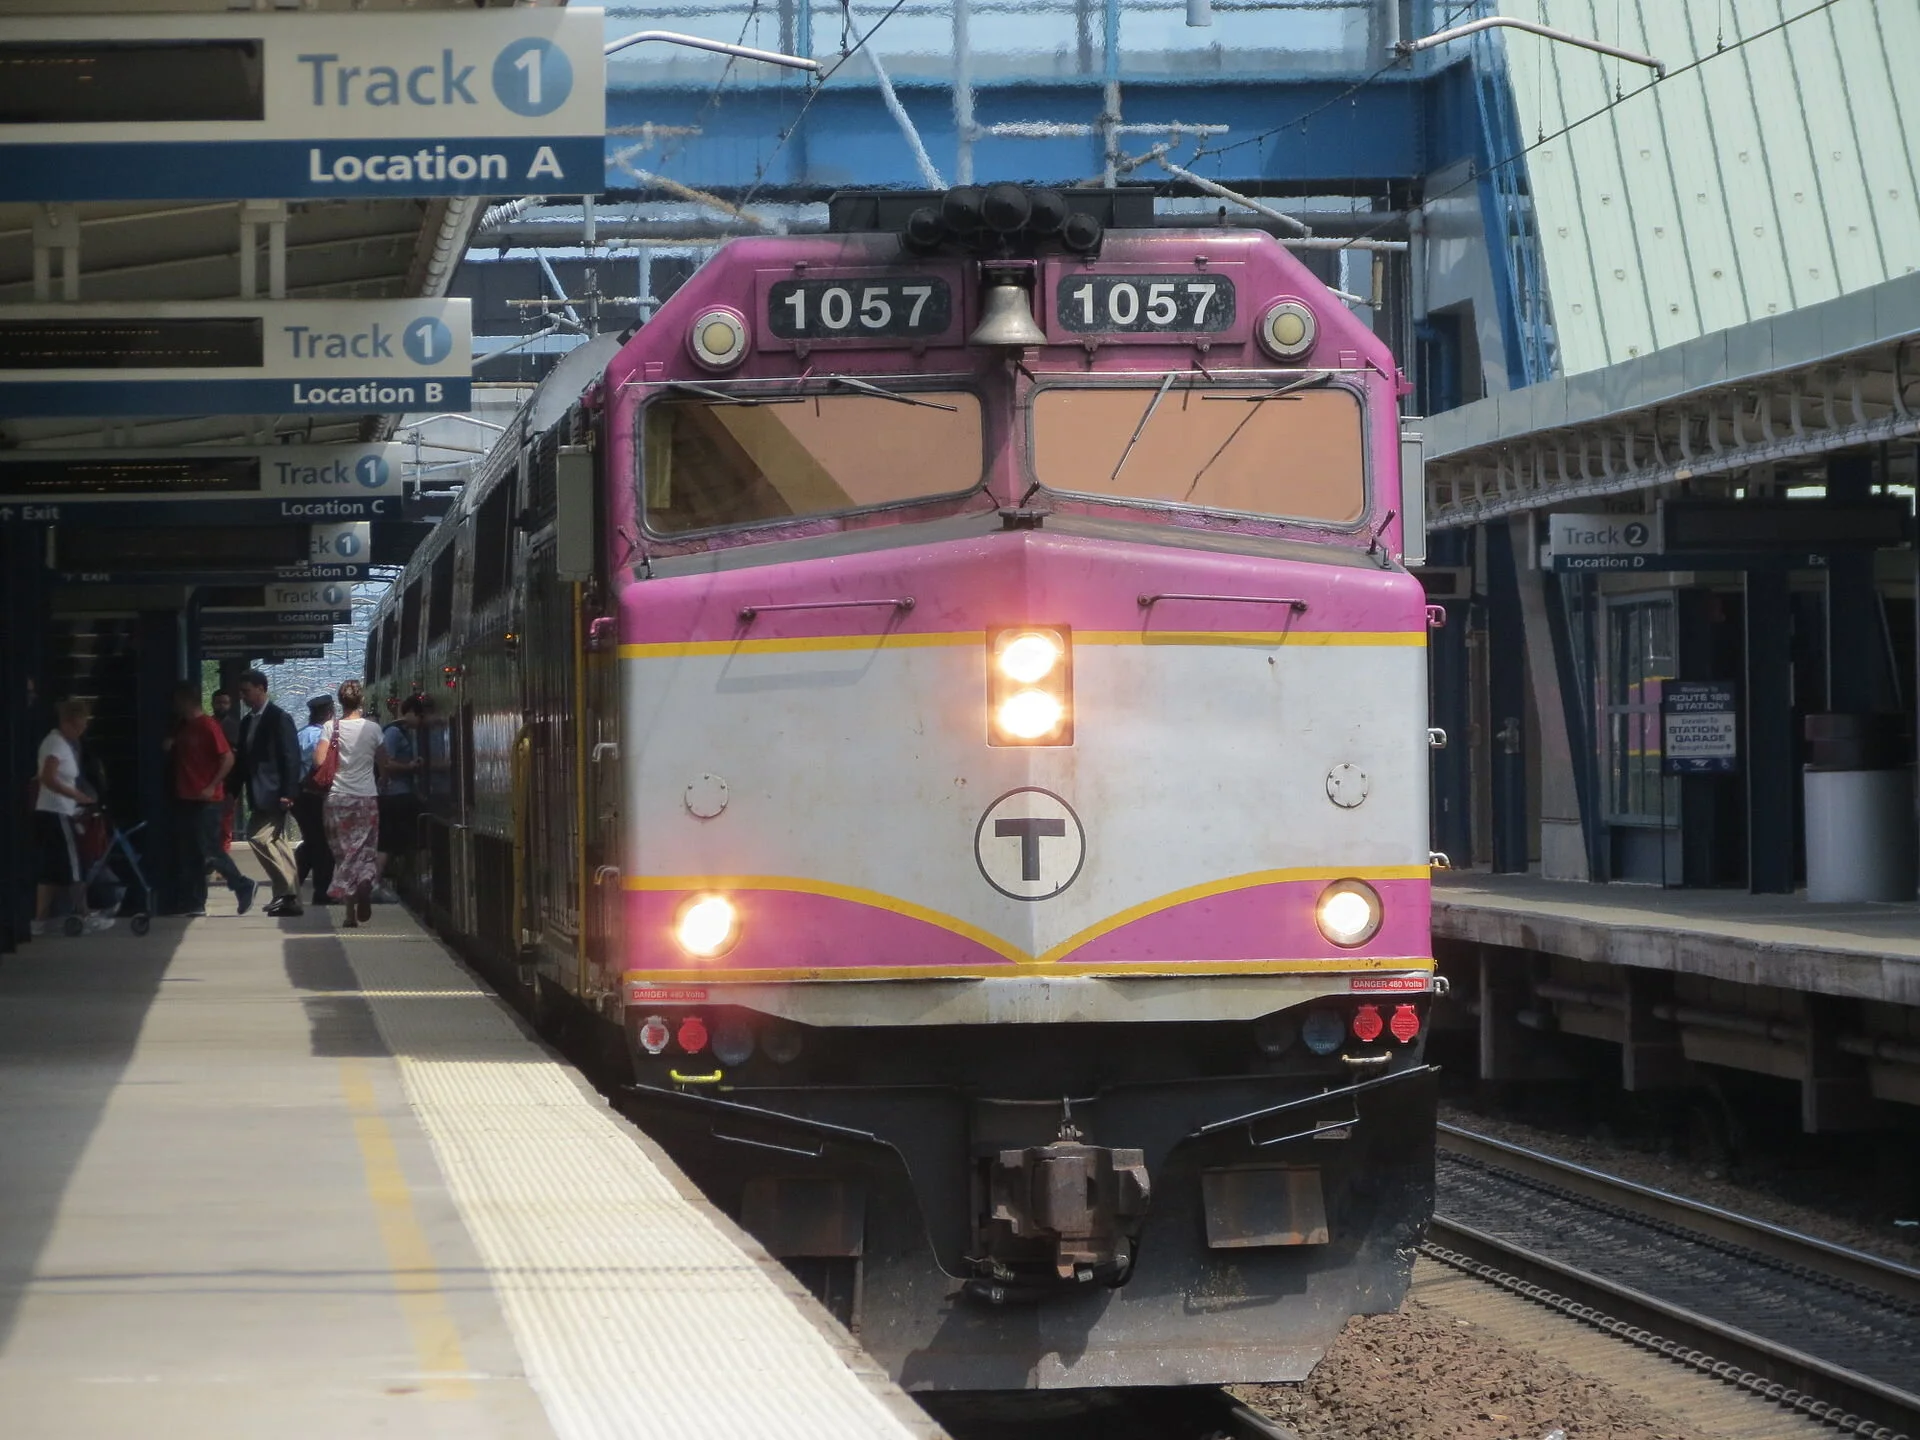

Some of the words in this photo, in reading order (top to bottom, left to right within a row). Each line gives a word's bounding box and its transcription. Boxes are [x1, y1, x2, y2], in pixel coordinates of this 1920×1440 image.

[297, 49, 477, 107] Track
[514, 49, 541, 104] 1
[310, 146, 507, 183] Location
[527, 147, 564, 179] A
[784, 286, 932, 329] 1057
[1072, 283, 1216, 326] 1057
[284, 322, 394, 359] Track
[415, 324, 434, 358] 1
[292, 382, 415, 405] Location
[425, 382, 443, 403] B
[275, 462, 349, 485] Track
[364, 460, 378, 483] 1
[22, 504, 60, 521] Exit
[281, 500, 369, 516] Location
[372, 500, 385, 515] C
[1563, 526, 1620, 544] Track
[1628, 528, 1643, 543] 2
[342, 536, 353, 554] 1
[1566, 556, 1629, 569] Location
[1632, 556, 1645, 568] D
[1807, 554, 1827, 567] Ex
[346, 565, 358, 577] D
[275, 588, 318, 604] Track
[327, 587, 336, 602] 1
[278, 611, 329, 622] Location
[332, 611, 341, 621] E
[1675, 702, 1724, 711] STATION
[1668, 725, 1719, 734] STATION
[1675, 734, 1726, 743] GARAGE
[994, 818, 1065, 881] T
[1353, 980, 1387, 988] DANGER
[1388, 980, 1403, 988] 480
[1404, 980, 1423, 988] Volts
[633, 990, 667, 999] DANGER
[686, 990, 706, 999] Volts
